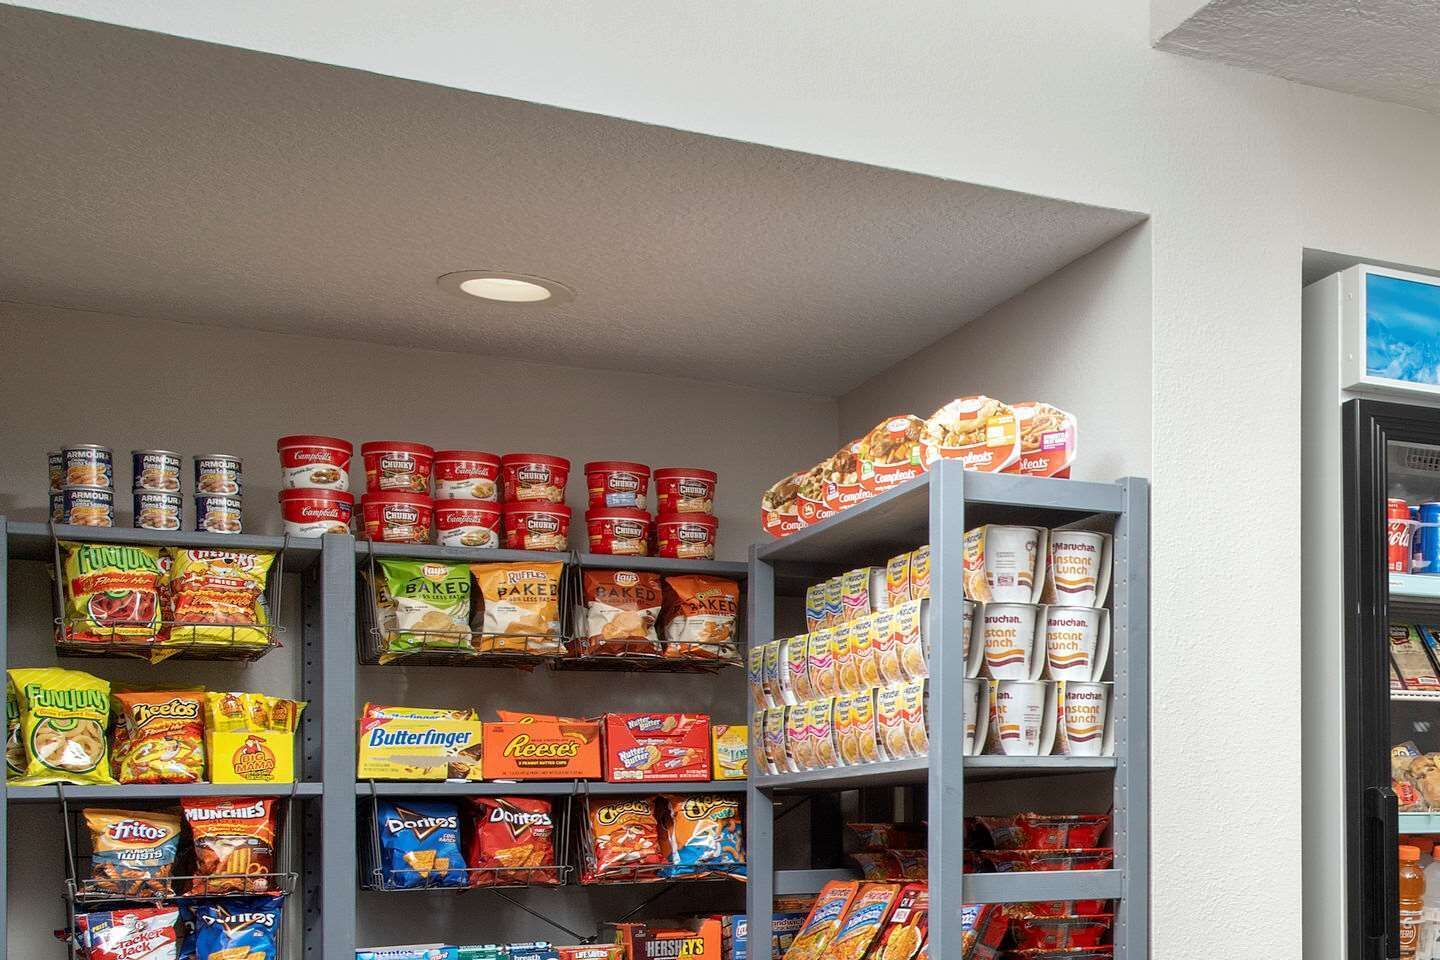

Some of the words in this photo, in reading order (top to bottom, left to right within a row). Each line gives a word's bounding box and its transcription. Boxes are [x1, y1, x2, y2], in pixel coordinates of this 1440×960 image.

[67, 451, 105, 459] ARMOUR
[144, 456, 179, 465] ARMOUR
[200, 461, 236, 469] ARMOUR
[382, 460, 413, 470] CHUNKY
[519, 470, 549, 482] CHUNKY
[609, 478, 639, 490] CHUNKY
[680, 484, 706, 495] CHUNKY
[71, 492, 110, 500] ARMOUR
[142, 495, 179, 504] ARMOUR
[207, 499, 240, 508] ARMOUR
[302, 506, 338, 518] Campbell's
[386, 510, 417, 522] CHUNKY
[528, 519, 558, 530] CHUNKY
[616, 525, 644, 536] CHUNKY
[680, 530, 706, 540] CHUNKY
[1054, 555, 1092, 564] Instant
[1056, 565, 1088, 575] Lunch
[508, 570, 547, 585] RUFFLES
[406, 581, 471, 595] BAKED
[497, 584, 558, 597] BAKED
[596, 586, 656, 601] BAKED
[690, 600, 738, 612] BAKED
[985, 615, 1020, 624] aruchan
[985, 628, 1016, 638] stant
[1048, 632, 1082, 641] nstant
[985, 638, 1013, 648] unch
[25, 683, 111, 713] FUNYUNS
[133, 699, 198, 723] Cheetos
[628, 717, 650, 729] Nutter
[640, 720, 661, 731] Butter
[370, 728, 472, 748] Butterfinger
[504, 735, 581, 758] Reese's
[241, 753, 265, 765] BIG
[619, 747, 645, 760] Nutter
[625, 752, 650, 768] Butter
[234, 760, 274, 774] MAMA
[184, 800, 265, 820] MUNCHIES
[490, 808, 552, 826] Doritos
[388, 816, 457, 833] Doritos
[118, 941, 152, 960] Jack
[646, 939, 704, 957] HERSHEY'S
